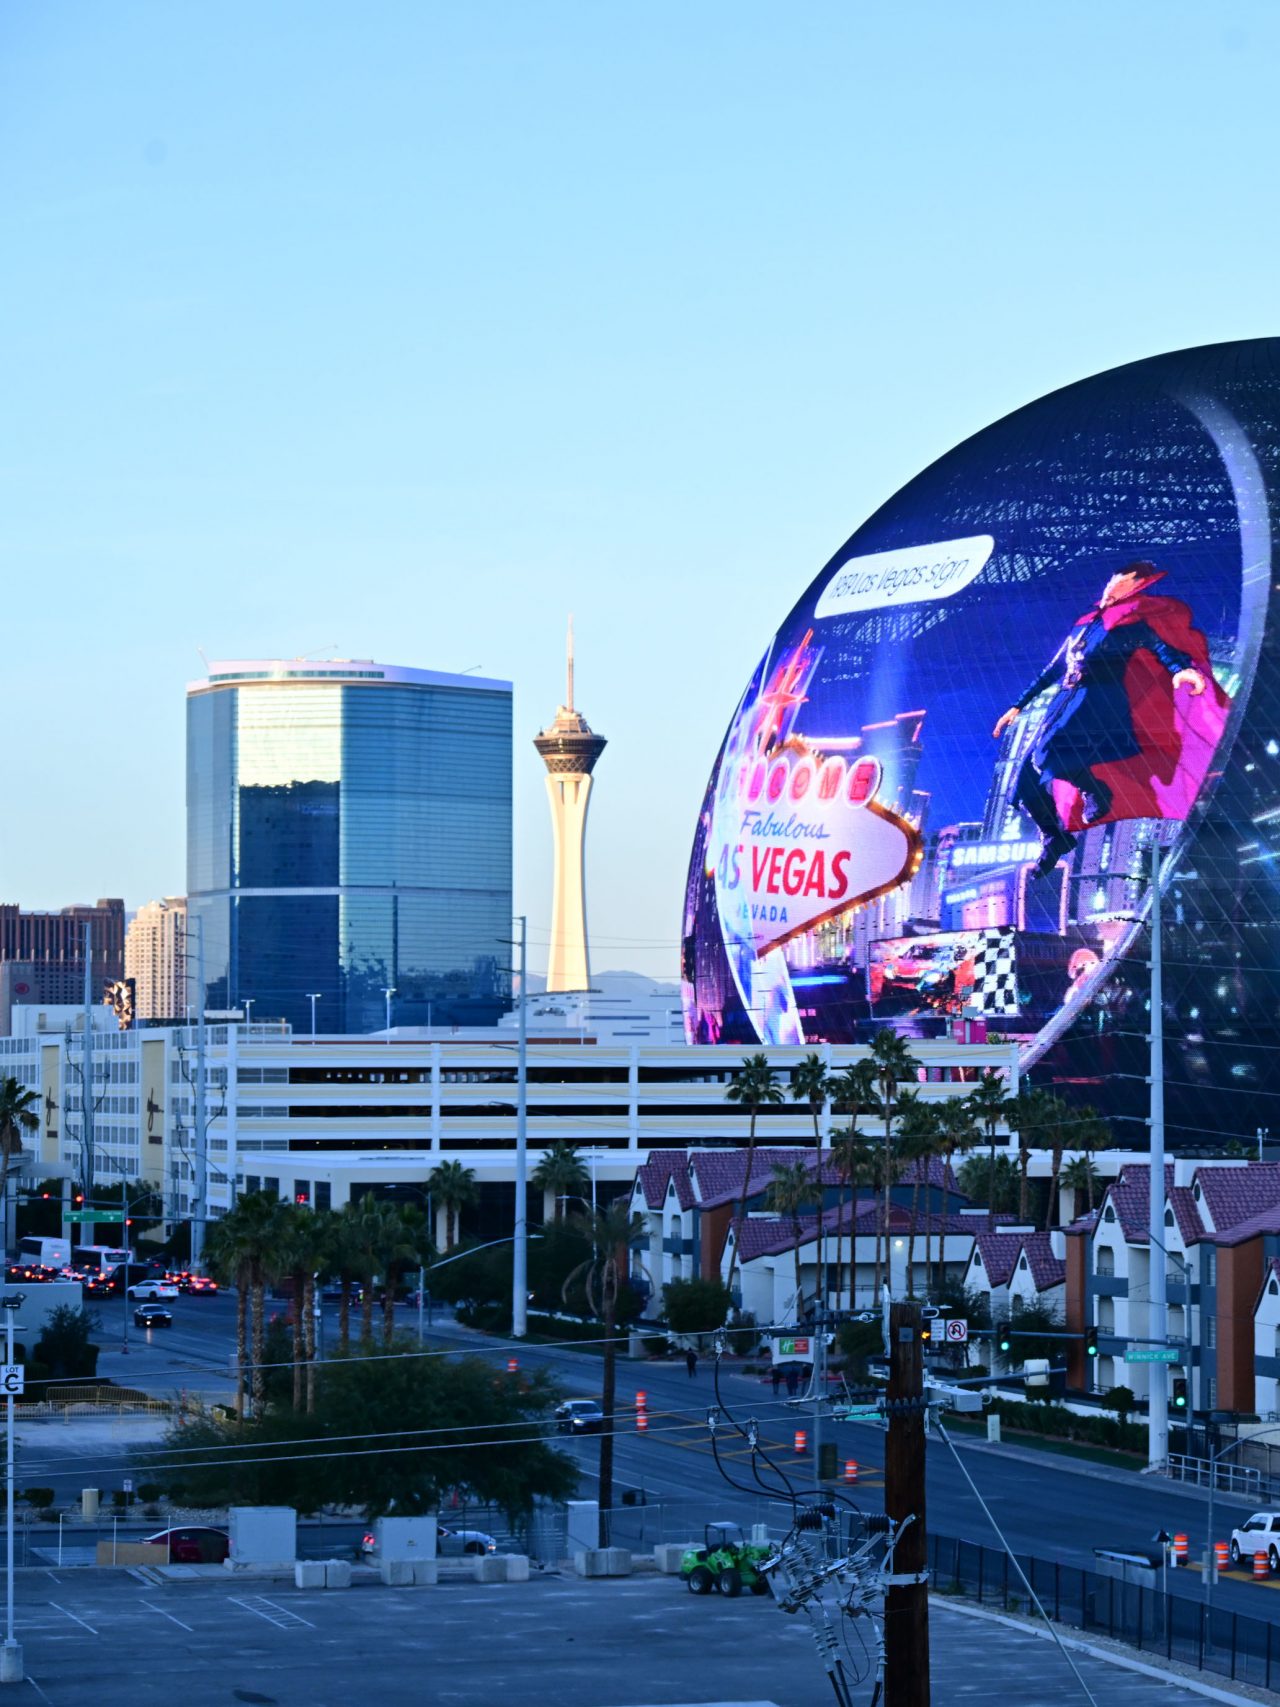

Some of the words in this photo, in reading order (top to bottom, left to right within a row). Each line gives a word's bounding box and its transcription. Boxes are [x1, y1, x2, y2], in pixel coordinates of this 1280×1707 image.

[877, 565, 929, 597] Vegas
[925, 556, 970, 590] sign
[740, 809, 830, 840] Fabulous
[951, 842, 1043, 867] SAMSUN
[751, 845, 852, 899] VEGAS
[5, 1373, 19, 1392] C
